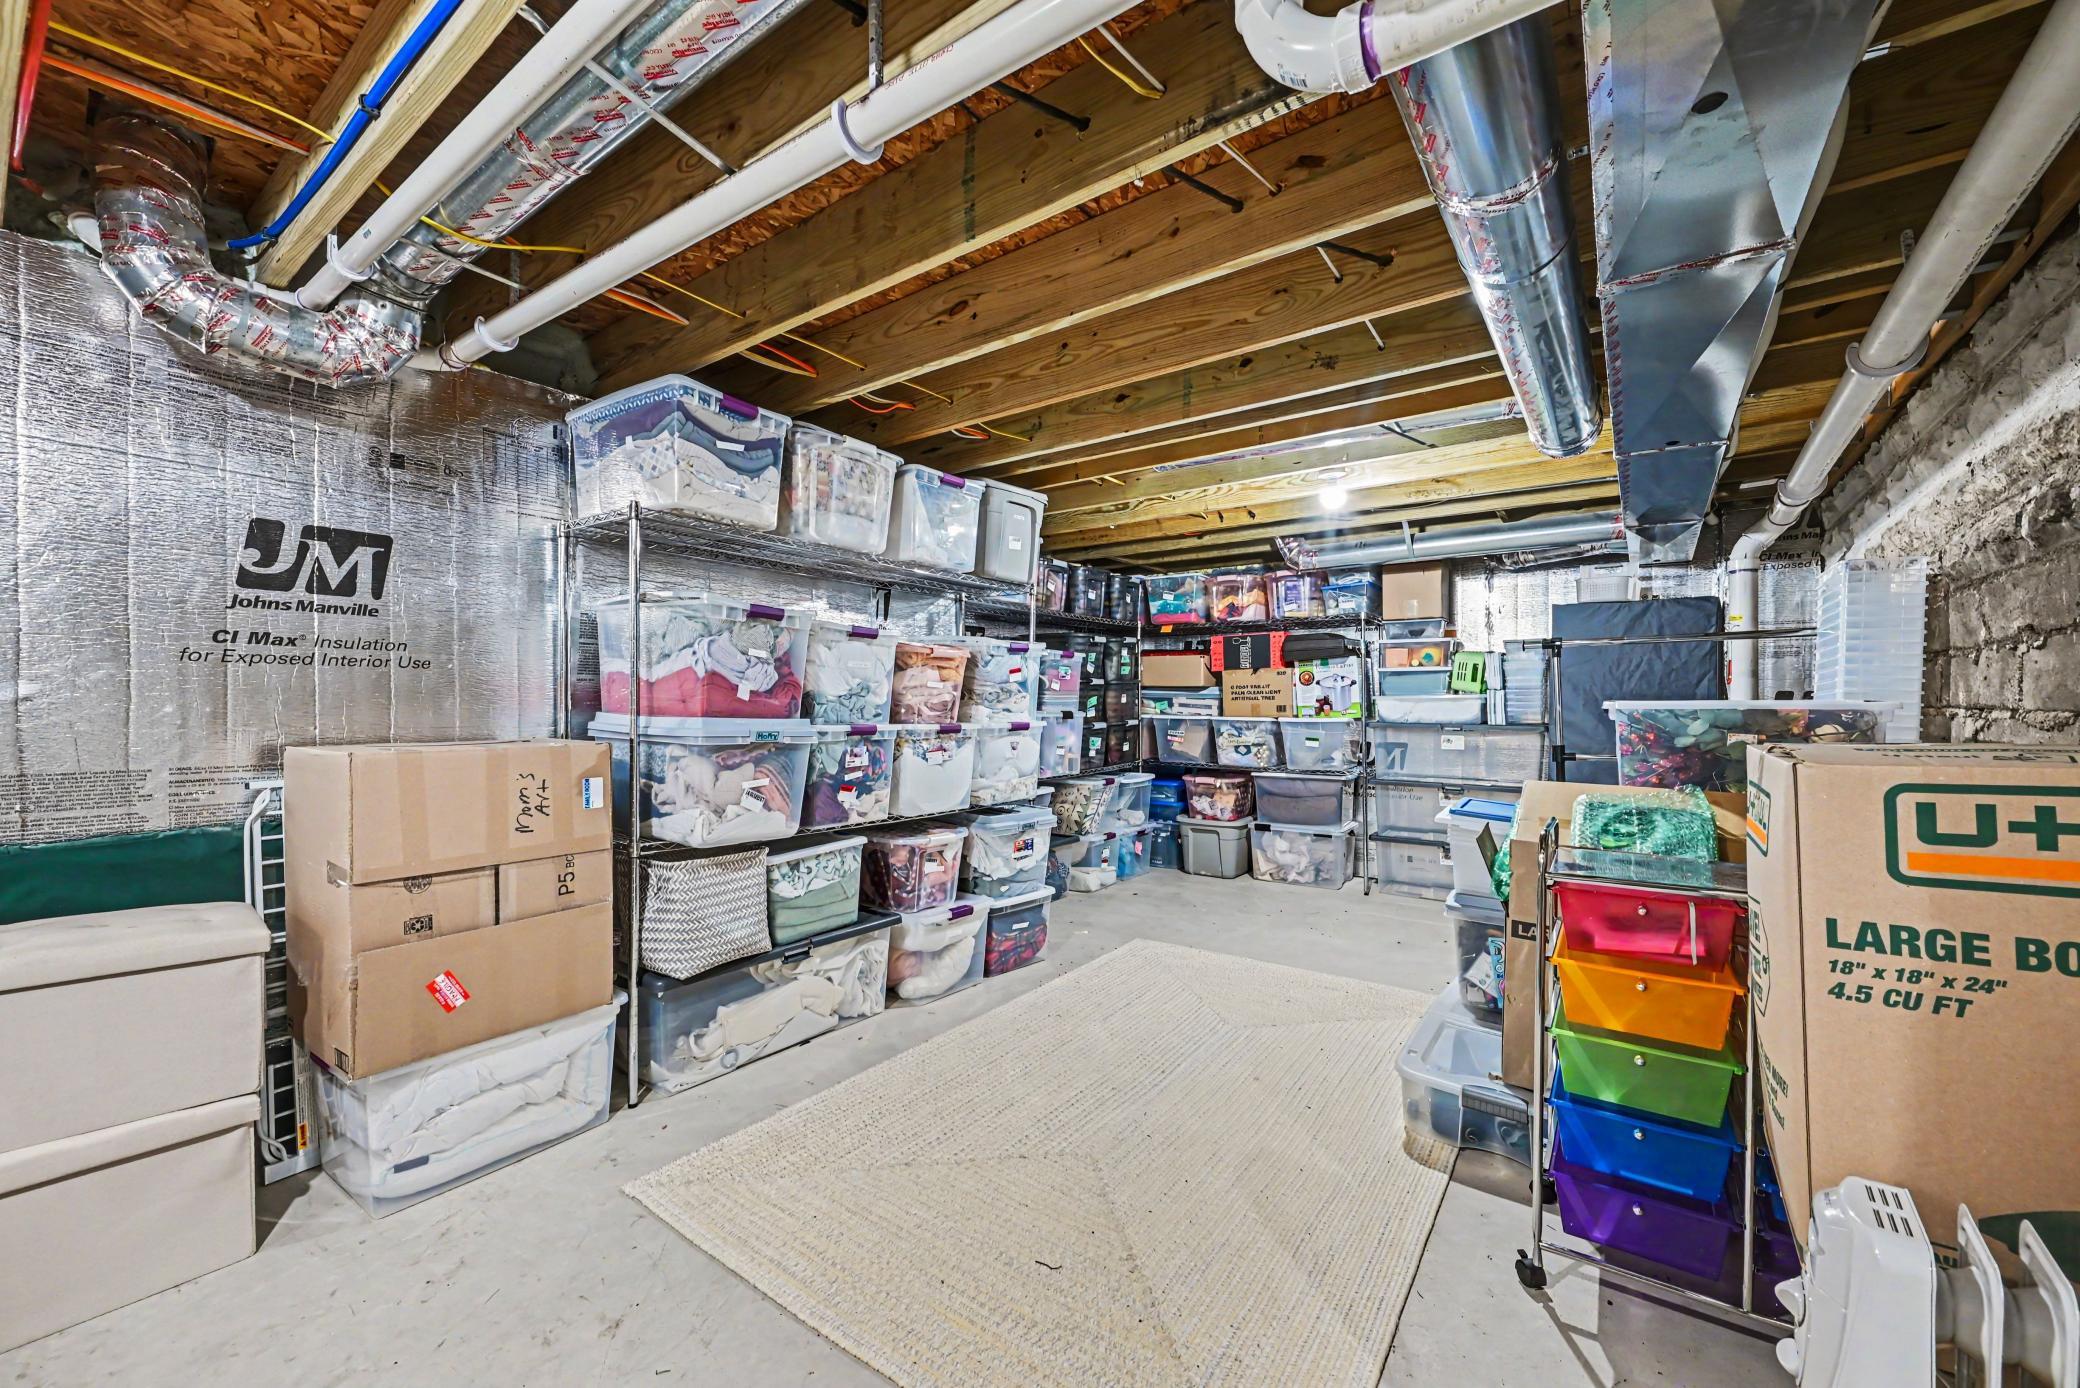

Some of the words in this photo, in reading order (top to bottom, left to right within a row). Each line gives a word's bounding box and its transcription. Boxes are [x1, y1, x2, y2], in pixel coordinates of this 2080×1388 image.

[236, 518, 393, 600] JM
[1763, 559, 1812, 571] Exposed
[225, 594, 292, 612] Johns
[295, 599, 379, 617] Manville
[211, 629, 238, 644] CI
[314, 634, 408, 652] Insulation
[179, 647, 216, 664] for
[221, 649, 314, 667] Exposed
[321, 652, 392, 668] Interior
[398, 655, 431, 670] Use
[1826, 917, 1992, 967] LARGE
[1828, 959, 1866, 975] 18"
[1872, 966, 1886, 980] x
[1895, 968, 1935, 985] 18"
[1942, 976, 1956, 990] x
[1962, 976, 2008, 994] 24"
[1827, 981, 1874, 1004] 4.5
[1882, 989, 1925, 1012] CU
[1931, 995, 1974, 1018] FT
